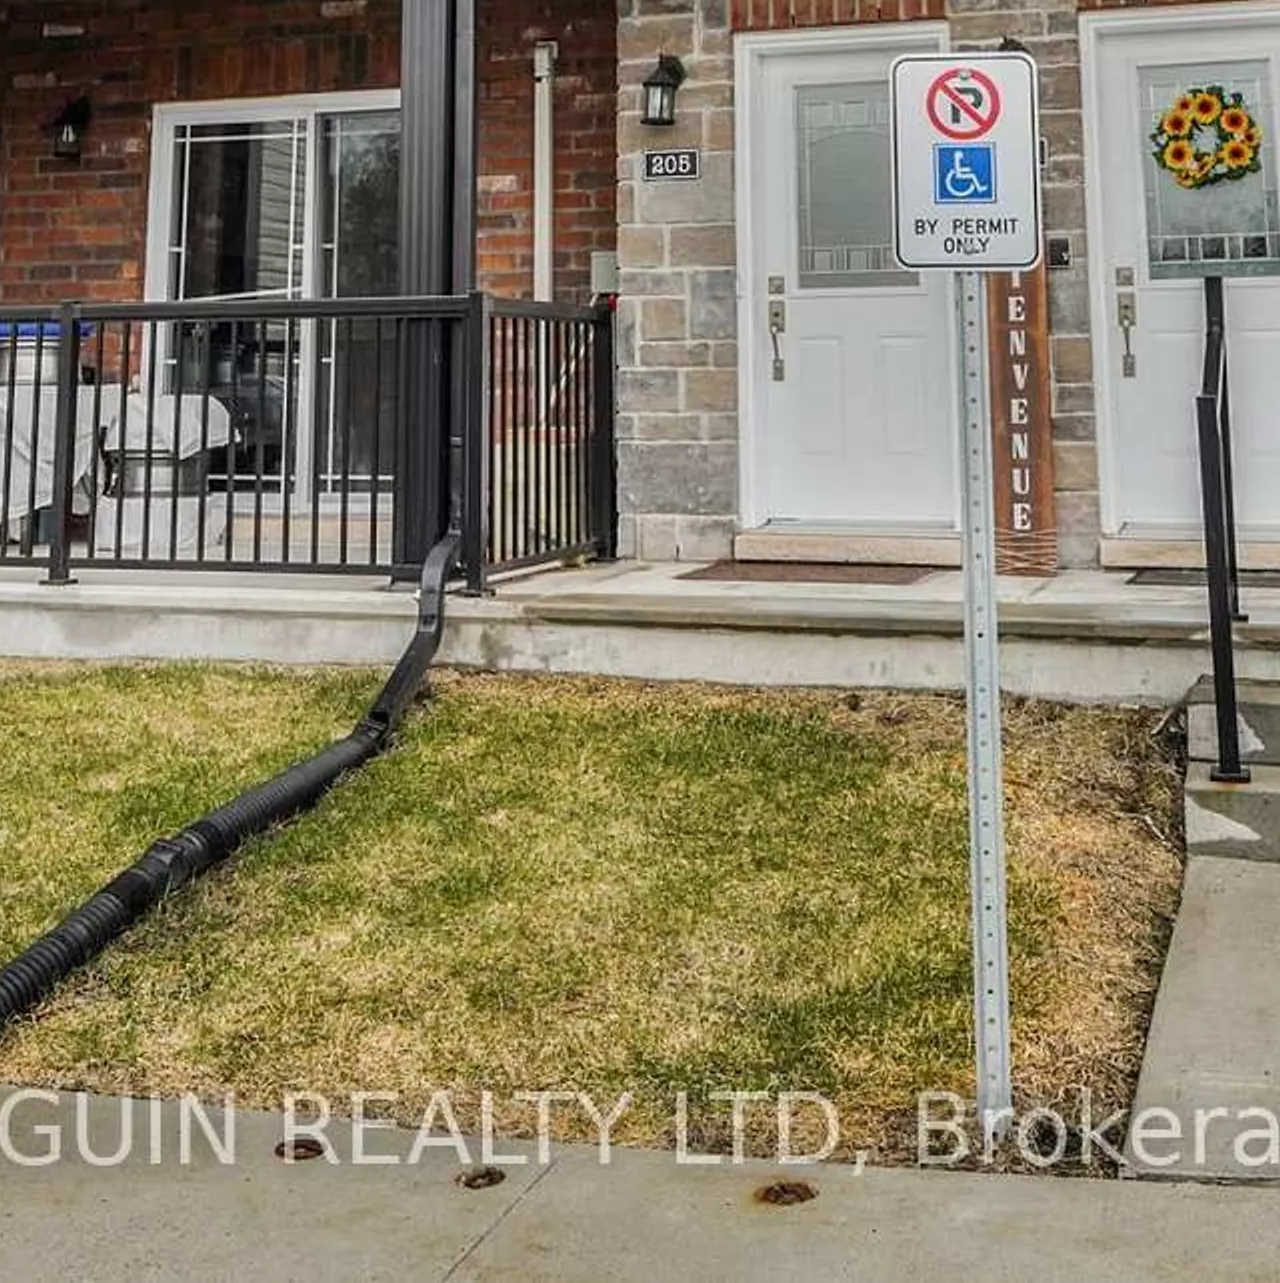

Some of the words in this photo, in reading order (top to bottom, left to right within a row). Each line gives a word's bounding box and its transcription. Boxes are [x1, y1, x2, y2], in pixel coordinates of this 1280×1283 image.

[651, 154, 691, 174] 205
[914, 219, 939, 235] BY
[952, 218, 1019, 235] PERMIT
